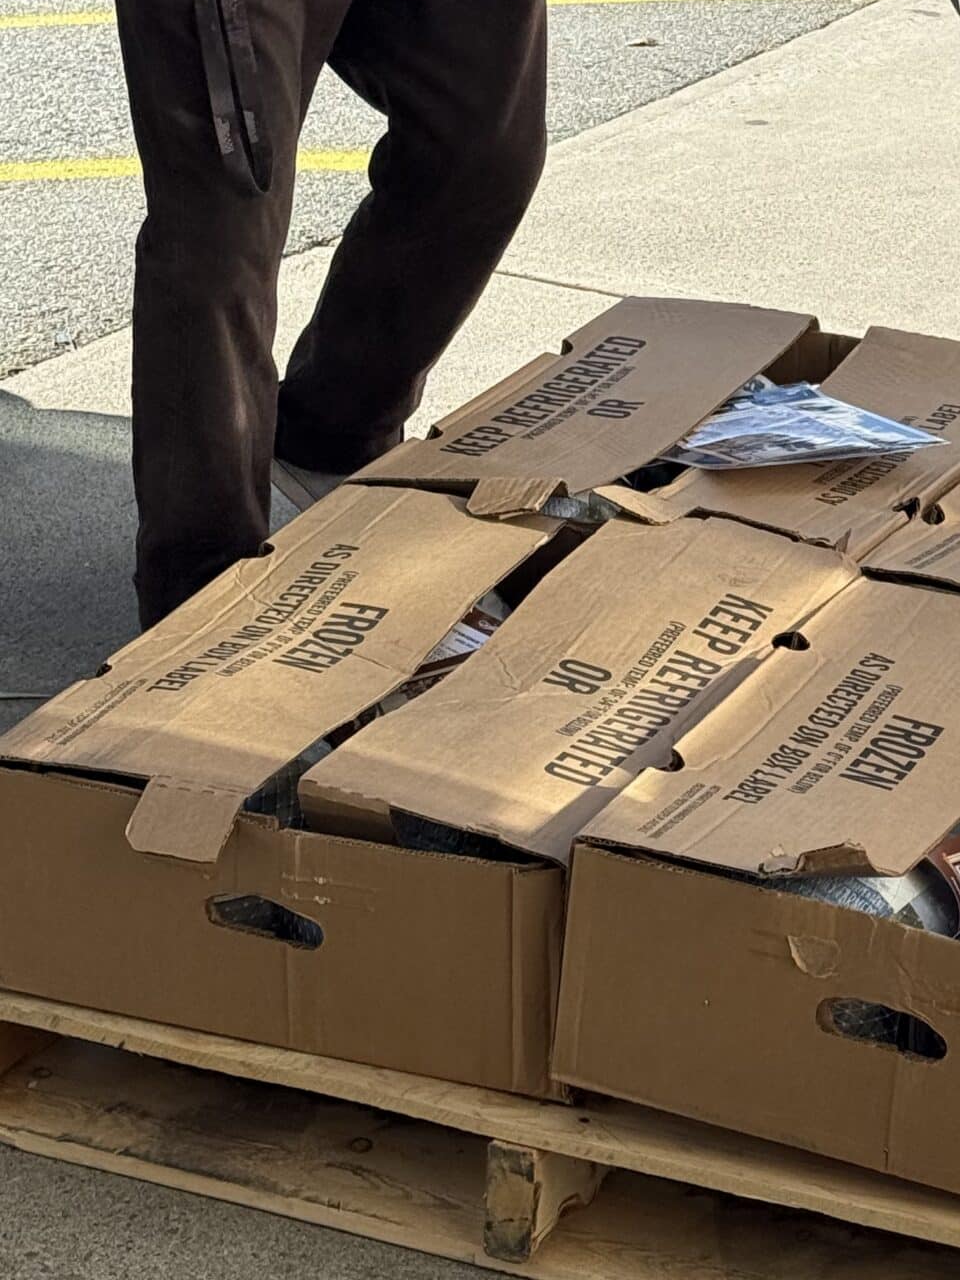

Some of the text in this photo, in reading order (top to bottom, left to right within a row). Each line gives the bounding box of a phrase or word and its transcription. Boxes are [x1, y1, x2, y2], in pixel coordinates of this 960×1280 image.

[440, 419, 514, 457] KEEP
[496, 336, 647, 428] REFRIGERATED
[587, 399, 646, 419] OR
[815, 492, 848, 506] AS
[830, 454, 897, 497] DIRECTED
[146, 543, 360, 693] AS DIRECTED ON BOX LABEL
[272, 602, 389, 674] FROZEN
[638, 621, 687, 668] (PREFERRED
[542, 659, 612, 695] OR
[544, 593, 774, 786] KEEP REFRIGERATED
[859, 684, 903, 723] (PREFERRED
[722, 652, 896, 804] AS DIRECTED ON BOX LABEL
[839, 714, 945, 791] FROZEN
